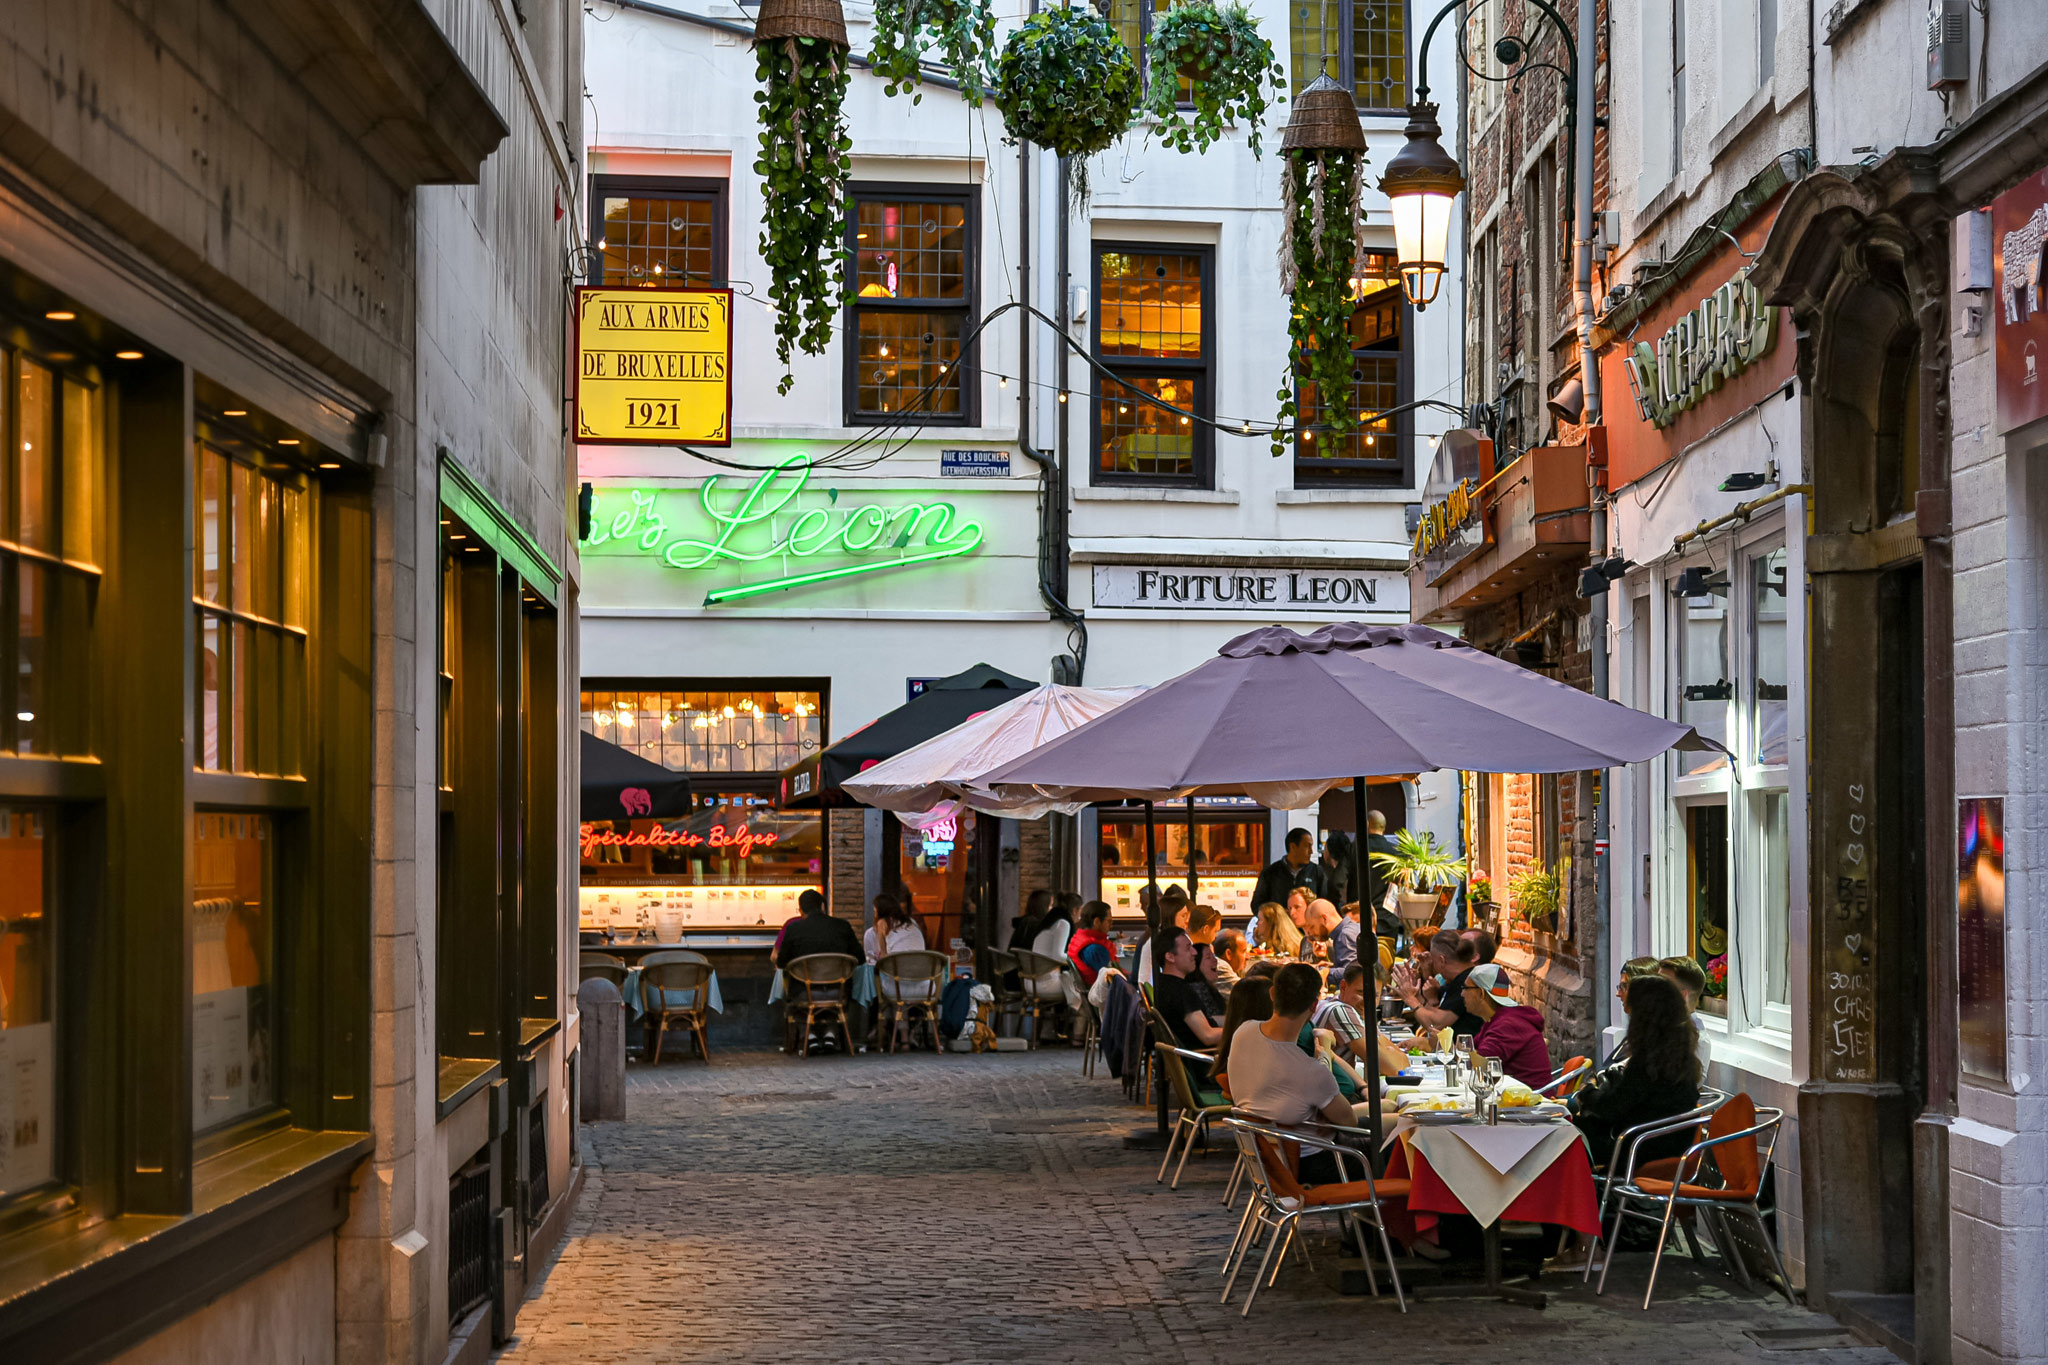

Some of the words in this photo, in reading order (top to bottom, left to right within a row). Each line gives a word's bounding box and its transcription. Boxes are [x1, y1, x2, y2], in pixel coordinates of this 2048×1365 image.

[599, 303, 634, 328] AUX
[645, 303, 710, 329] ARMES
[583, 353, 606, 378] DE
[616, 353, 724, 378] BRUXELLES
[626, 402, 679, 427] 1921
[943, 451, 956, 462] RUE
[958, 452, 972, 462] DES
[973, 452, 1009, 463] BOUCHERS
[942, 466, 1009, 476] BEENHOUWERSSTRAAT
[1136, 569, 1277, 604] FRITURE
[1287, 572, 1378, 605] LEON
[580, 823, 703, 858] Spécialités
[709, 824, 778, 858] Belges
